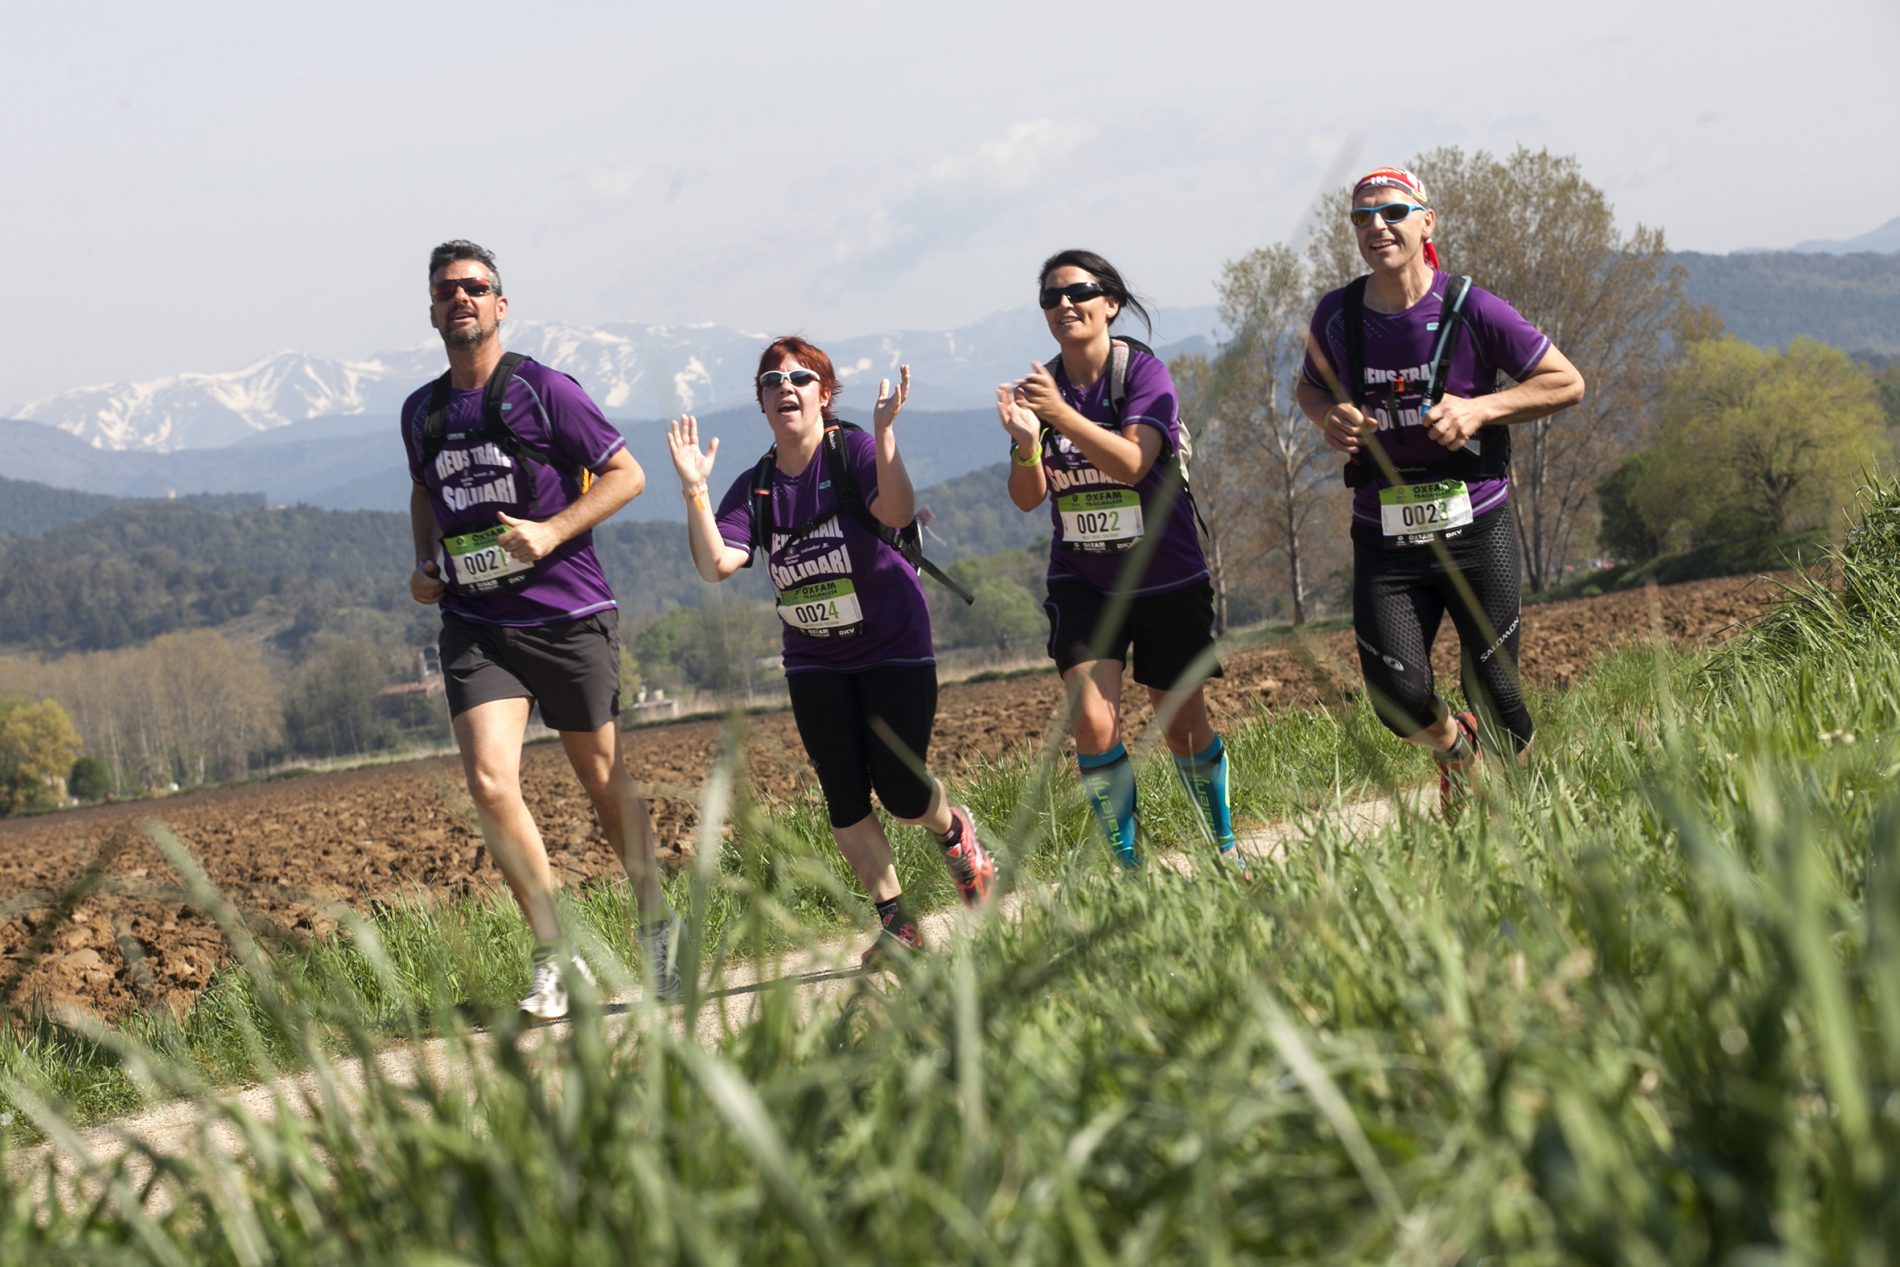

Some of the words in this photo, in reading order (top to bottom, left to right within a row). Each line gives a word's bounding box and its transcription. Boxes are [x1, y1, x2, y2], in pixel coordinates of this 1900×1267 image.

[1086, 492, 1122, 502] OXFAM
[1077, 511, 1120, 534] 0022
[1402, 502, 1448, 526] 0023
[464, 547, 507, 575] 0021
[771, 543, 852, 589] SOLIDARI
[802, 582, 836, 595] OXFAM
[795, 600, 839, 623] 0024
[838, 628, 855, 636] DKV
[1480, 616, 1519, 662] SALOMON
